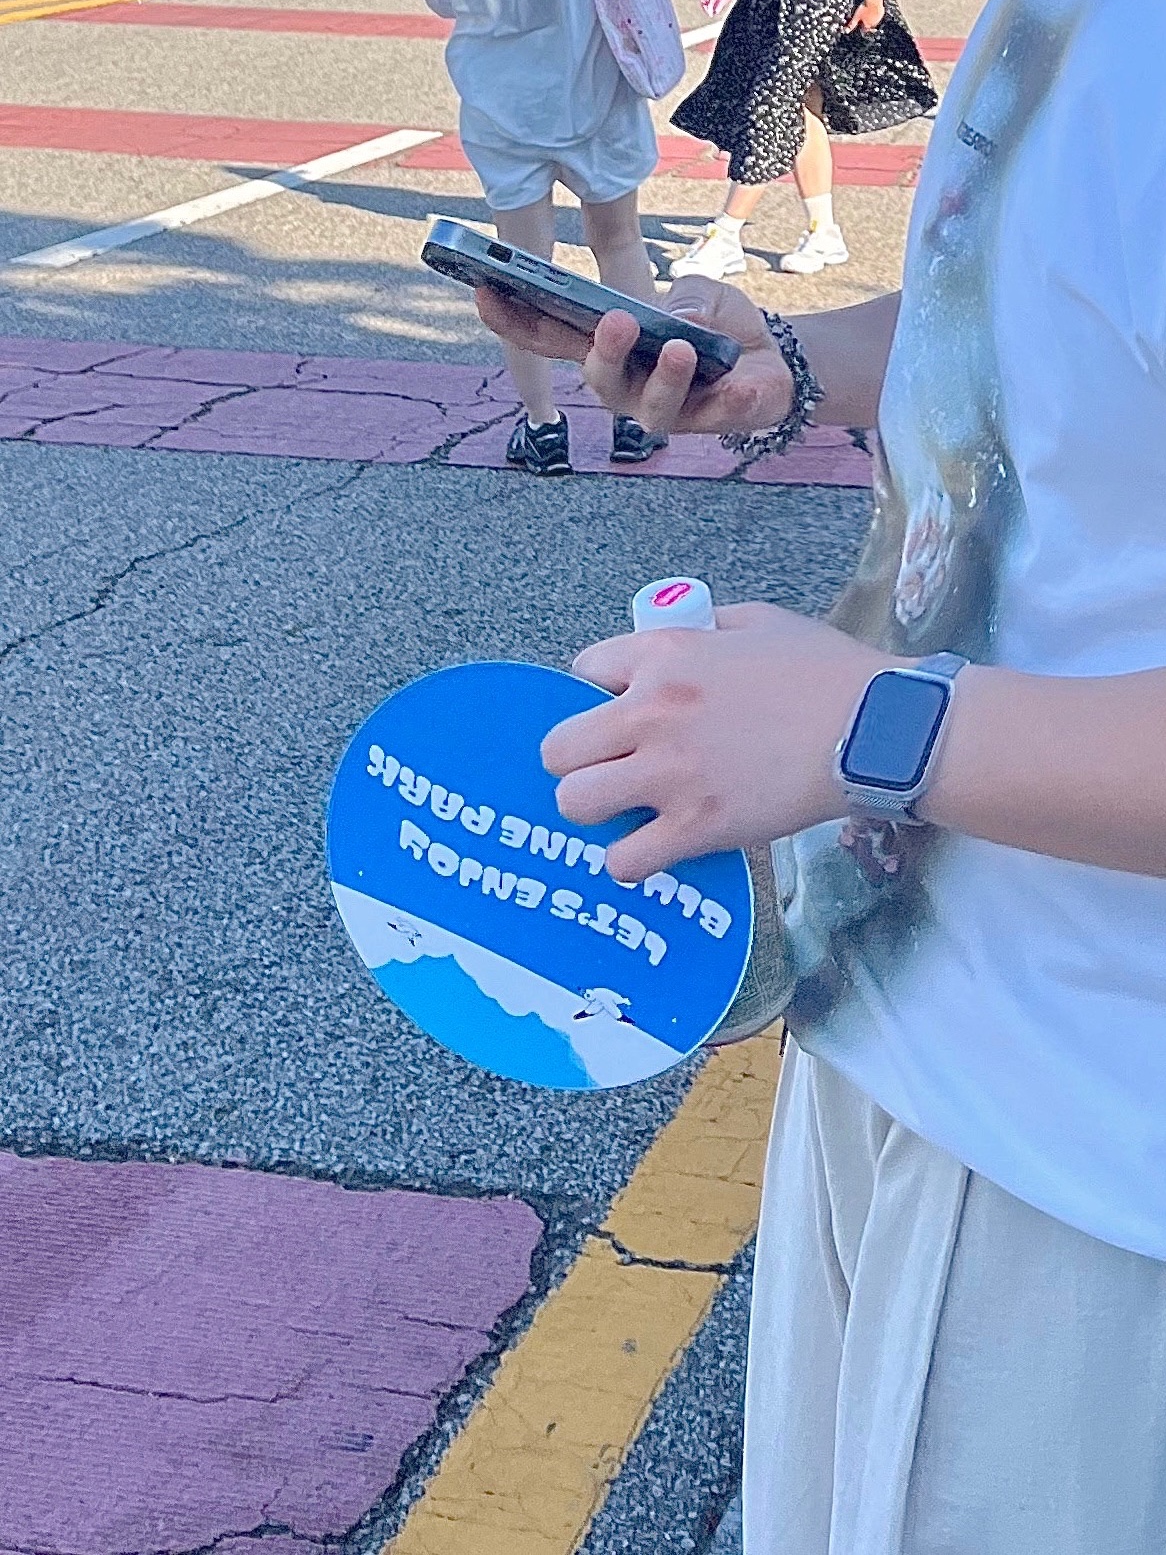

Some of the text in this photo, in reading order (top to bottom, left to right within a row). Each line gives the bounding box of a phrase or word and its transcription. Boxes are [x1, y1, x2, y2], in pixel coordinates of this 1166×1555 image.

[366, 744, 733, 940] BLU LINE PARK
[399, 819, 668, 967] LET'S ENJOY
